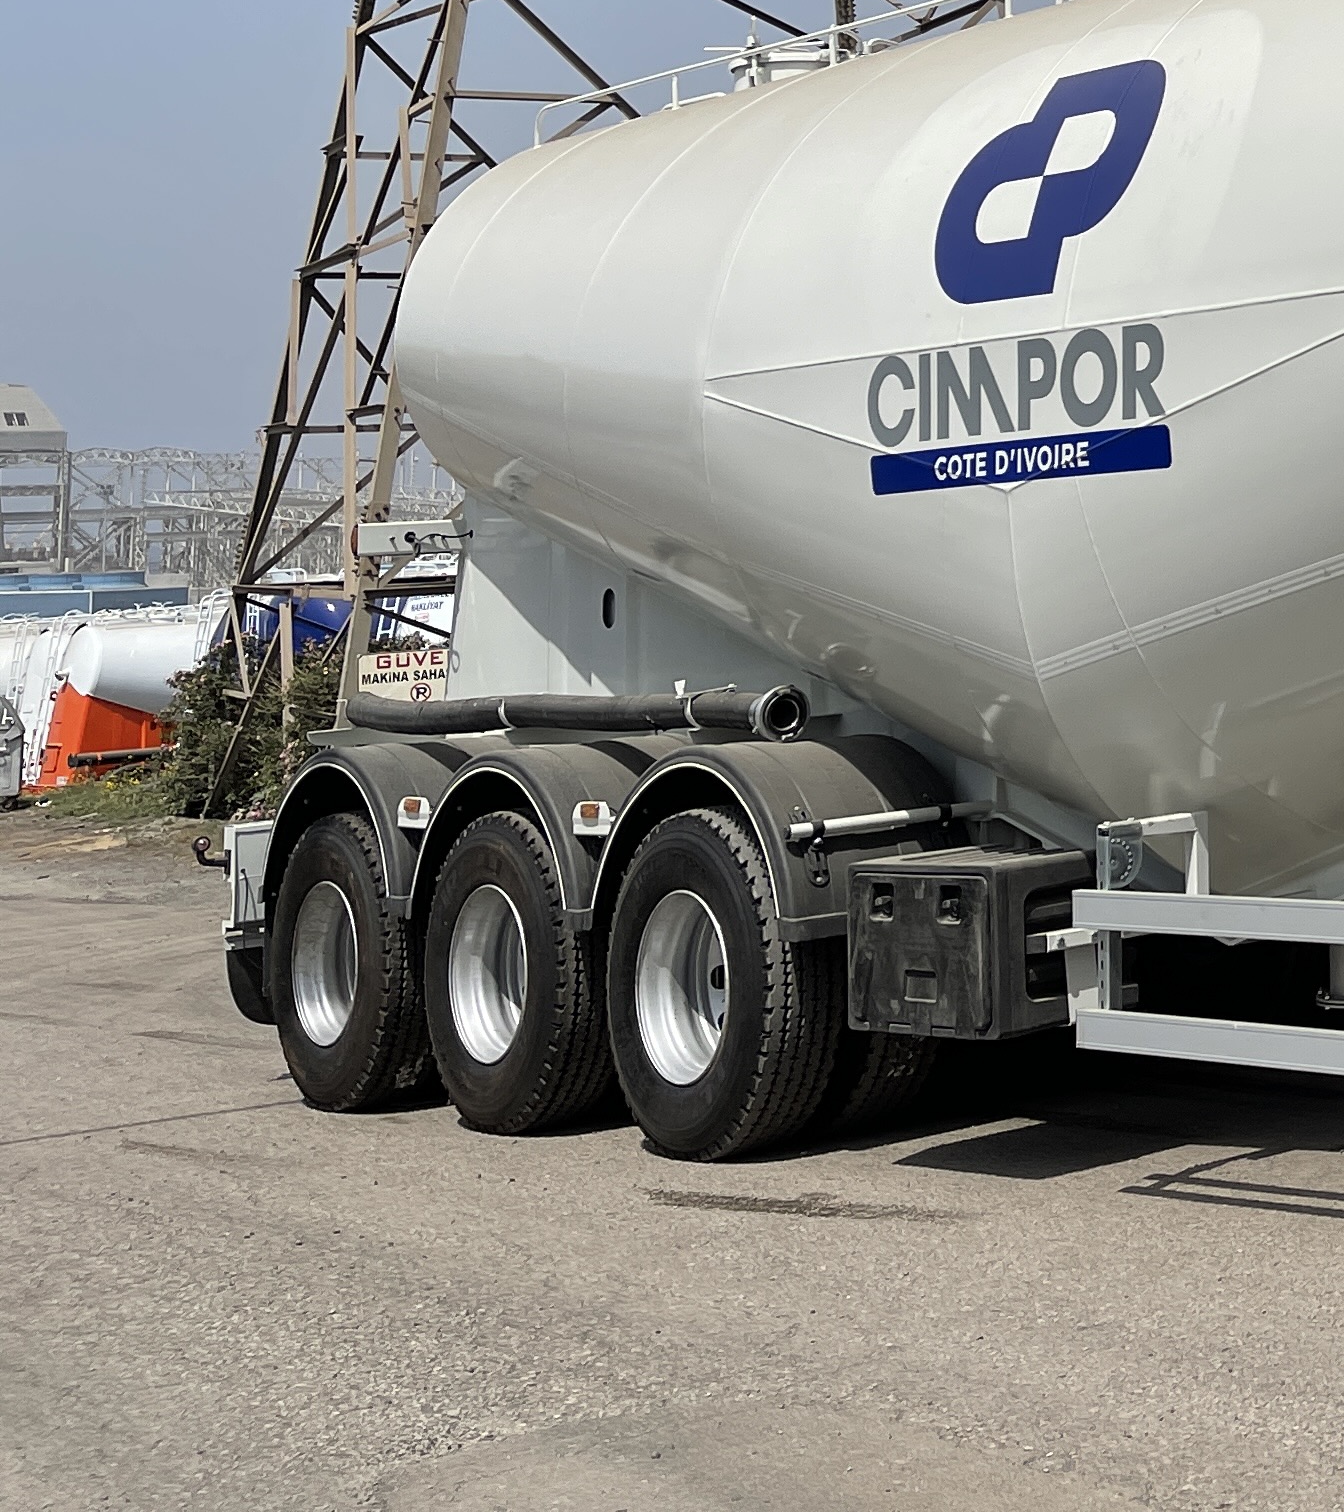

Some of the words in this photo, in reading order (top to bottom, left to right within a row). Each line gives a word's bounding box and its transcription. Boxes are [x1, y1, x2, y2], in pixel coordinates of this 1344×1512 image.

[868, 323, 1166, 447] CIMPOR
[934, 451, 987, 481] COTE
[995, 441, 1090, 475] D'IVOIRE
[376, 651, 444, 669] GÜVE
[413, 668, 447, 681] SAHA
